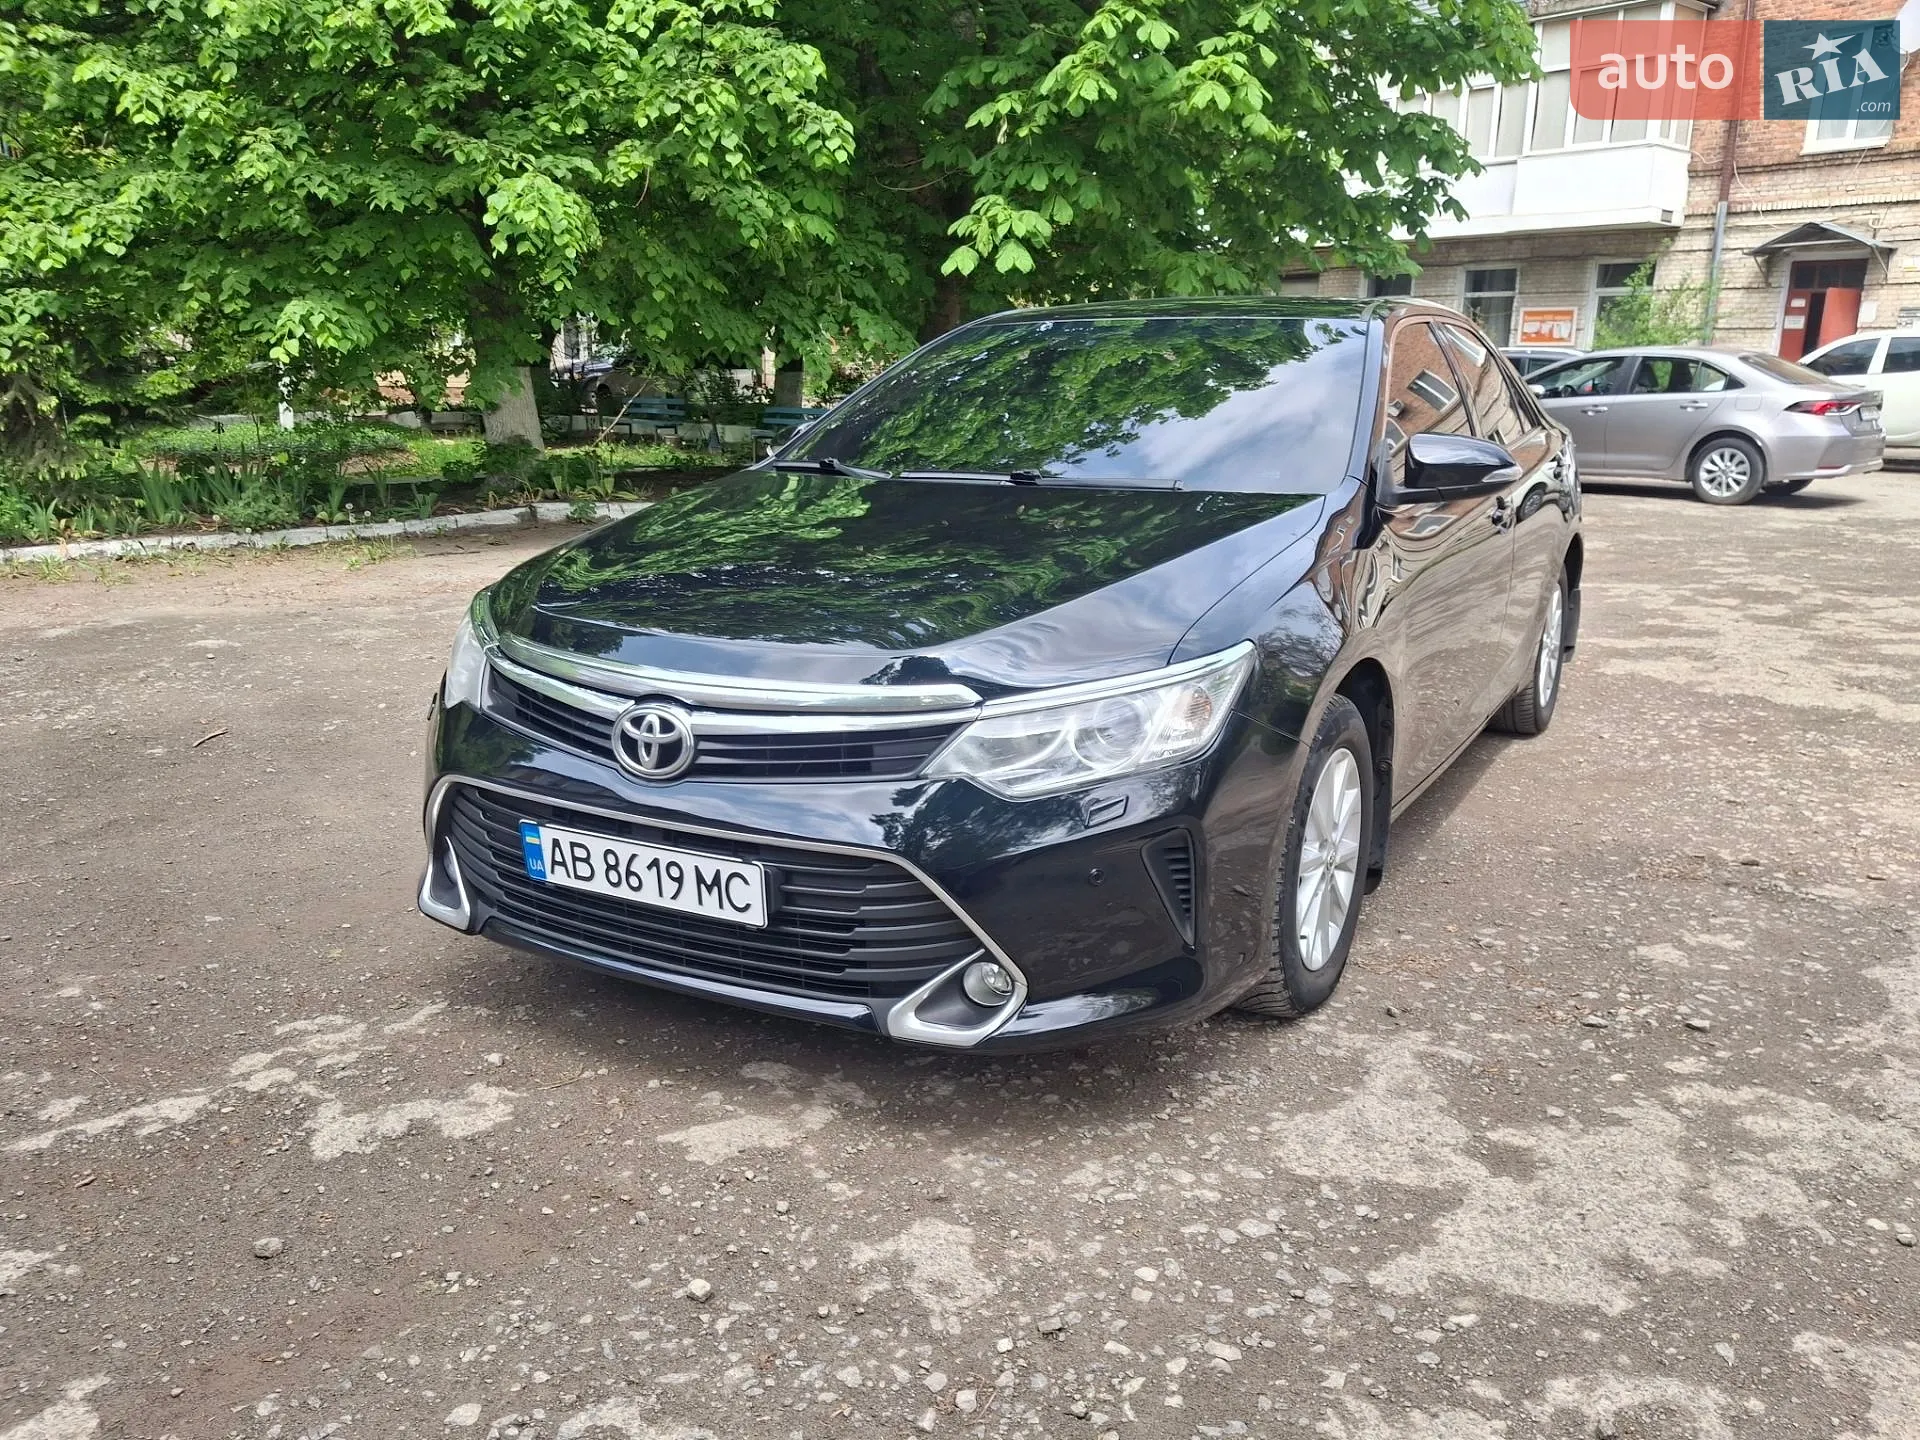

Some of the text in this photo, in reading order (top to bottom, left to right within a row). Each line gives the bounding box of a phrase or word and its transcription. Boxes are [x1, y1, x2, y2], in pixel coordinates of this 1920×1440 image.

[529, 857, 545, 872] UA
[550, 837, 752, 913] AB 8619 MC
